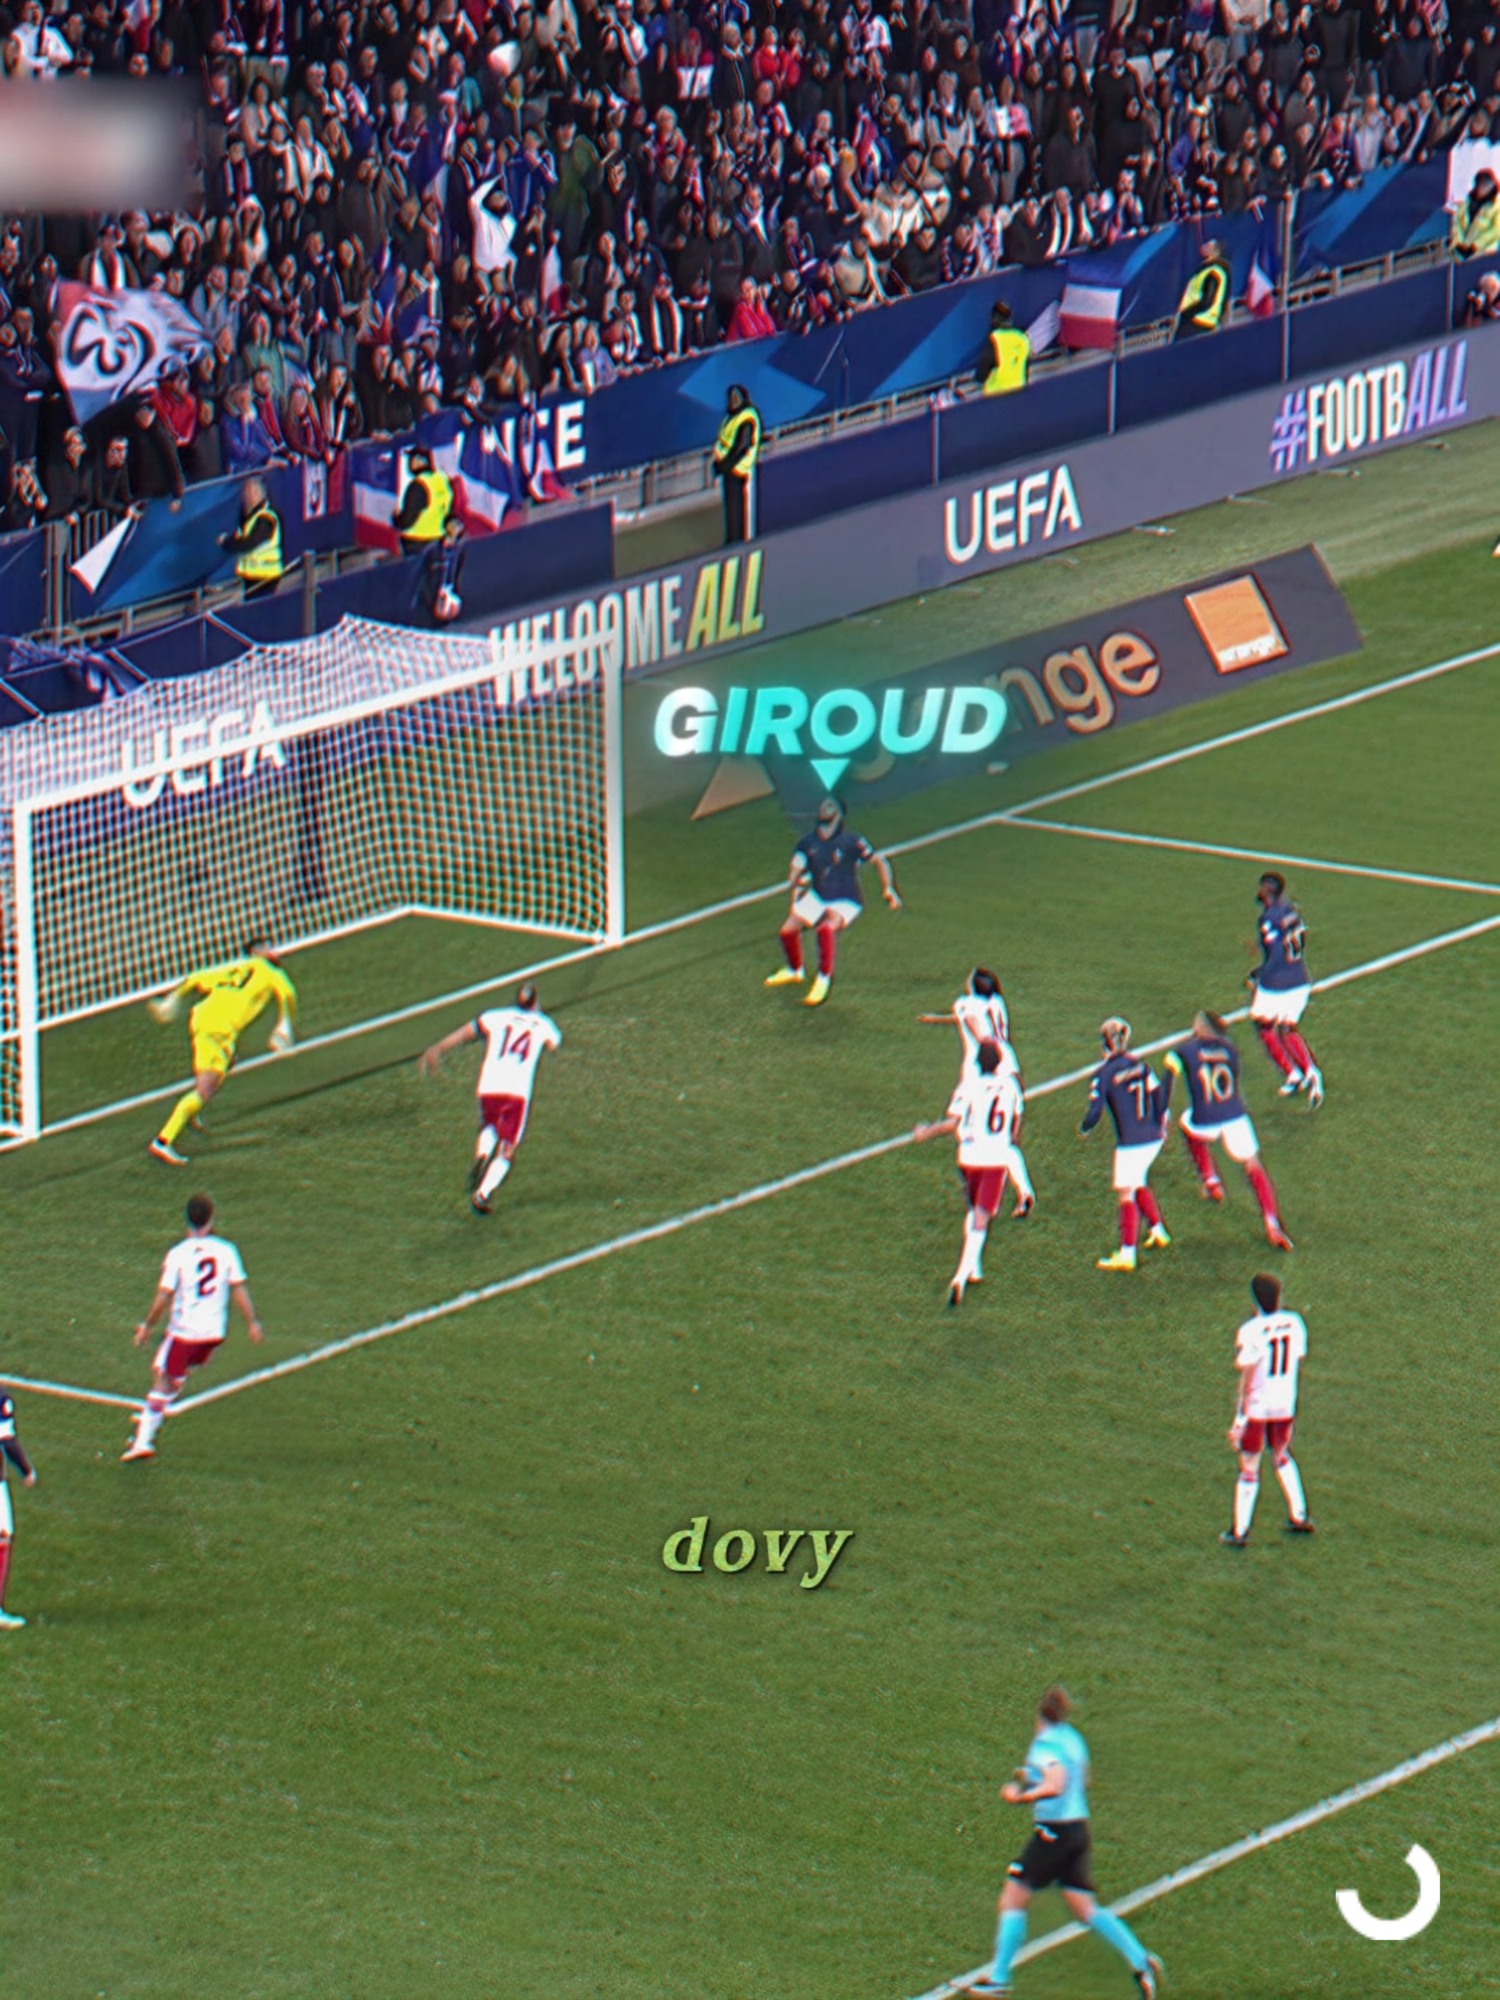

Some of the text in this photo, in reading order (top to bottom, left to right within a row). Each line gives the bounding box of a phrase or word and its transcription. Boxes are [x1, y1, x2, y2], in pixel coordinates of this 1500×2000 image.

[1268, 339, 1468, 474] #FOOTBALL
[943, 464, 1082, 565] UEFA
[685, 550, 765, 653] ALL
[497, 1023, 533, 1064] 14
[1127, 1079, 1146, 1121] 7
[1197, 1062, 1235, 1104] 10
[987, 1095, 1006, 1135] 6
[196, 1256, 218, 1300] 2
[1267, 1335, 1291, 1378] 11
